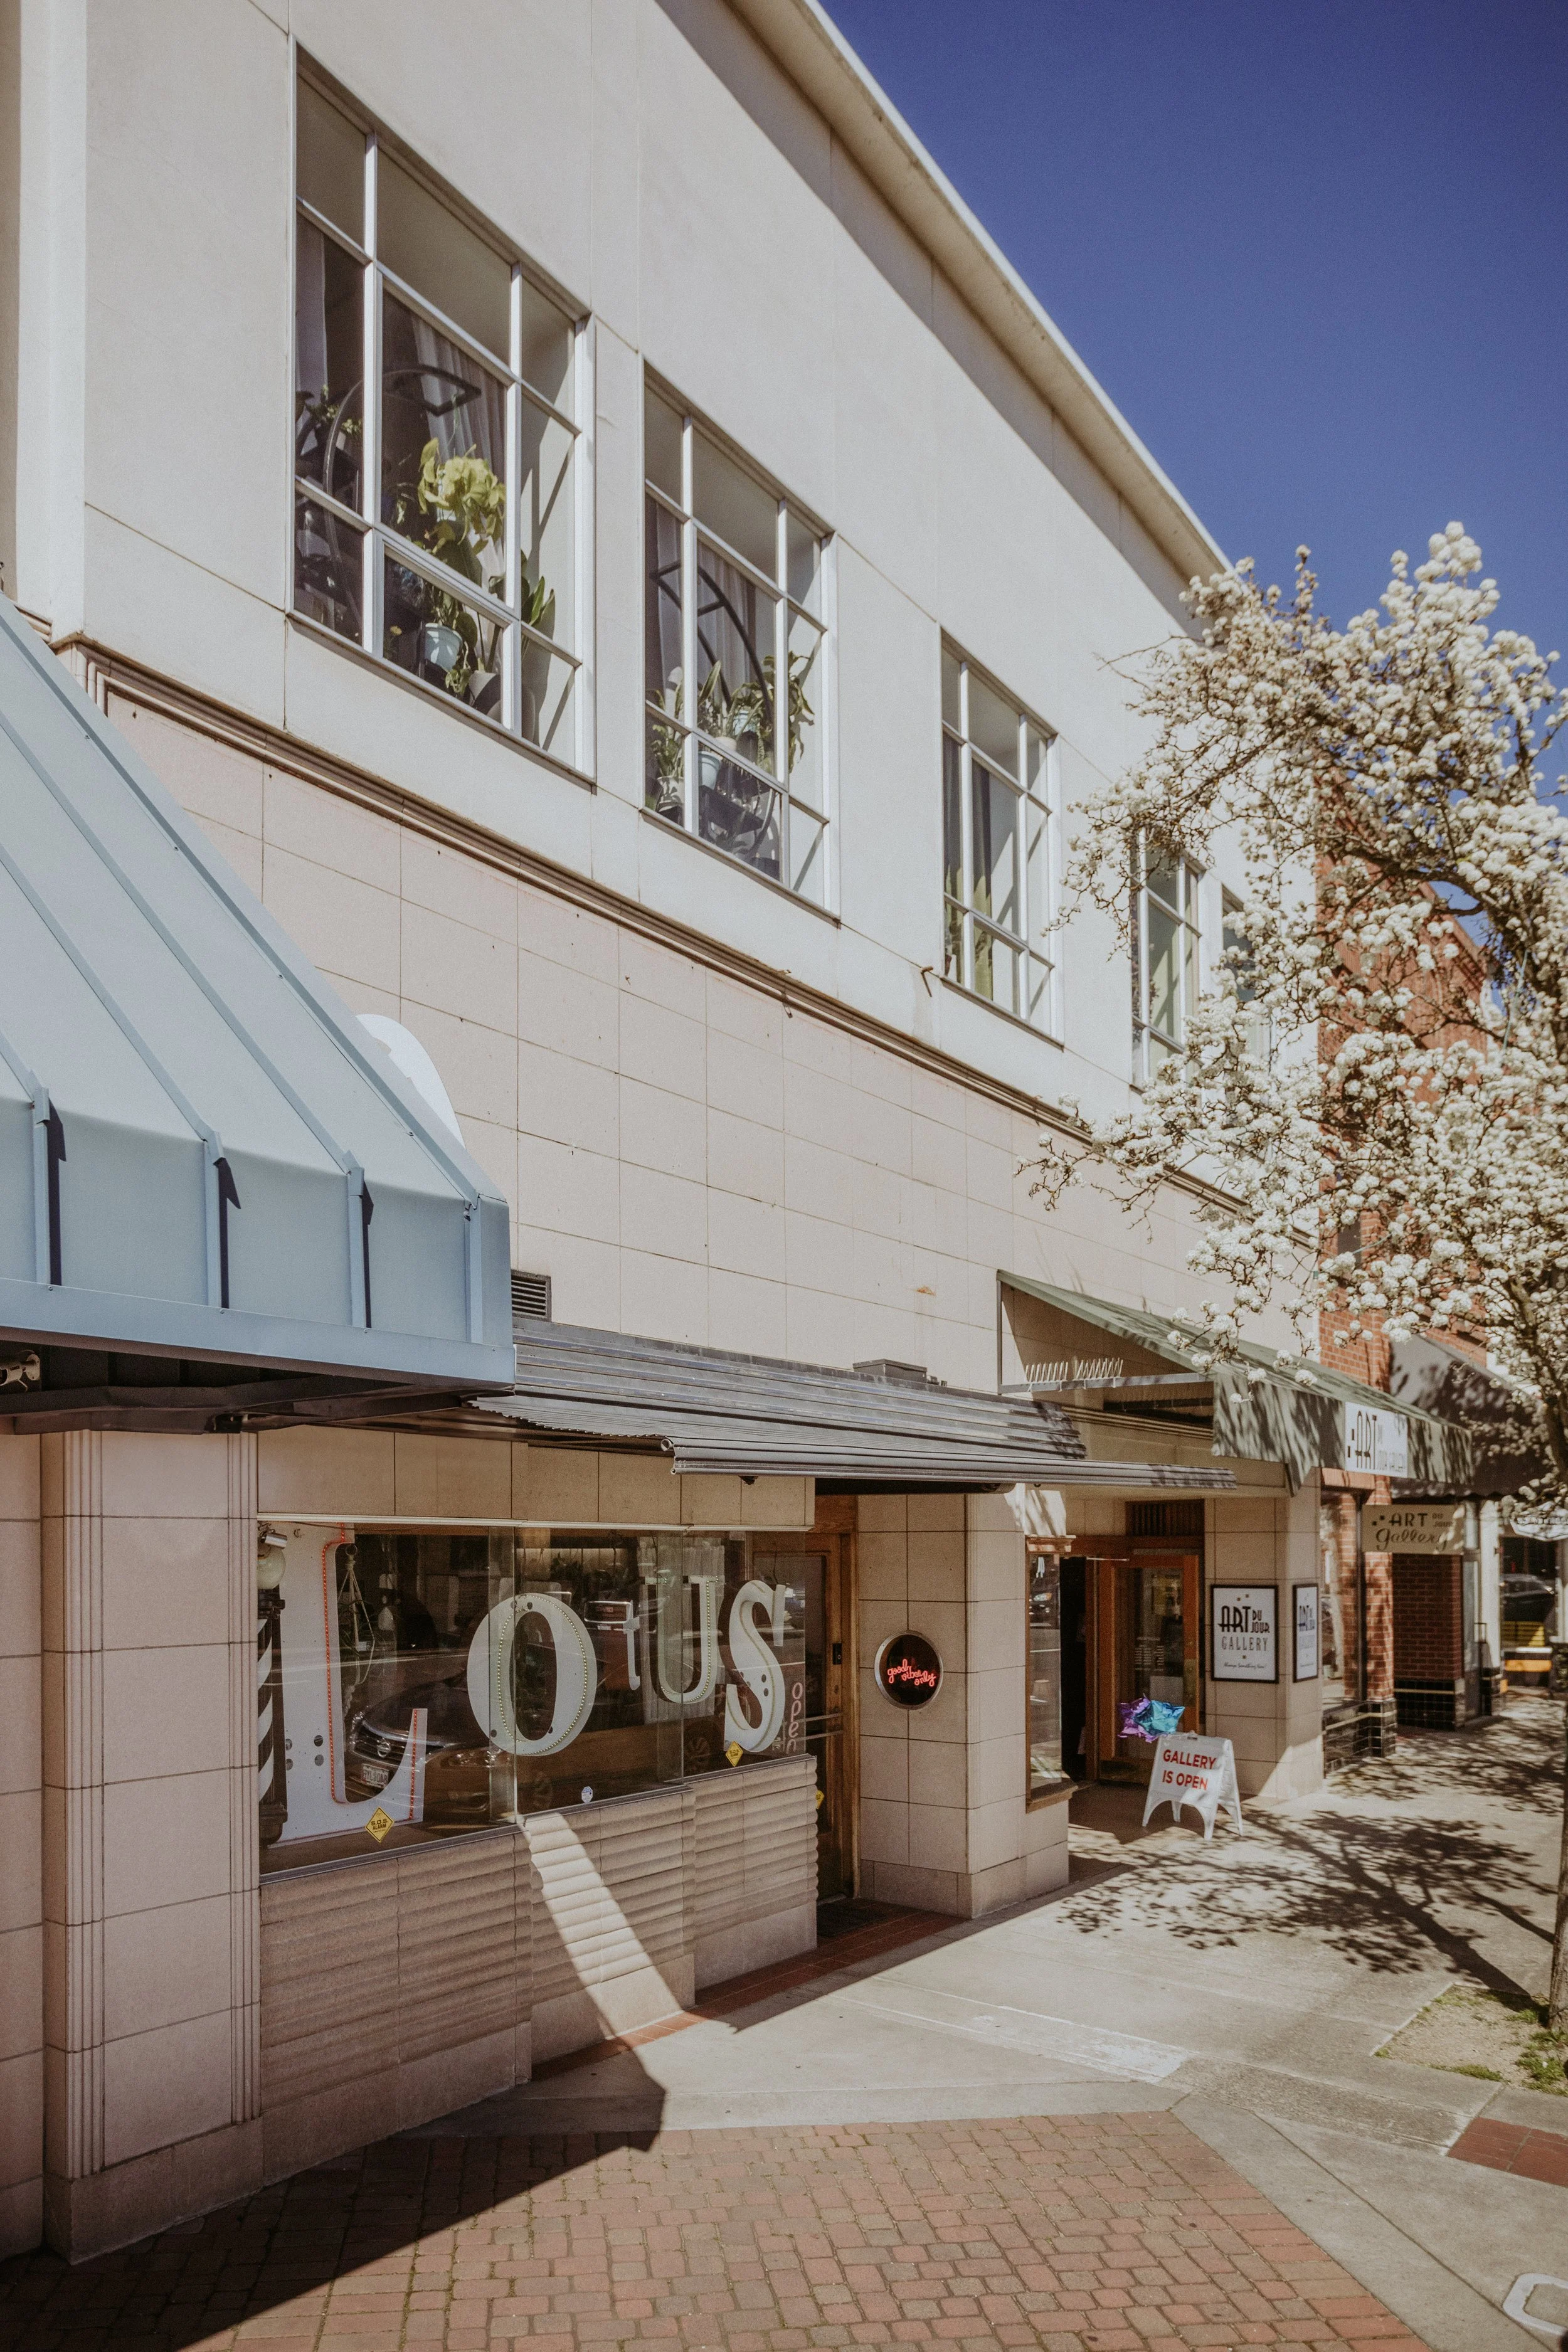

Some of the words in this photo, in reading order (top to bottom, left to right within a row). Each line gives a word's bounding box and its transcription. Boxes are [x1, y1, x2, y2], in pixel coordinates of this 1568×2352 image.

[1355, 1410, 1377, 1470] ART
[1389, 1512, 1428, 1527] ART
[1217, 1605, 1251, 1633] ART
[1252, 1609, 1263, 1621] DU
[1251, 1621, 1270, 1634] JOUR
[1221, 1636, 1268, 1651] GALLERY
[887, 1658, 910, 1684] good
[914, 1671, 936, 1687] only
[1163, 1749, 1217, 1770] GALLERY
[1162, 1770, 1173, 1784] IS
[1176, 1772, 1208, 1791] OPEN
